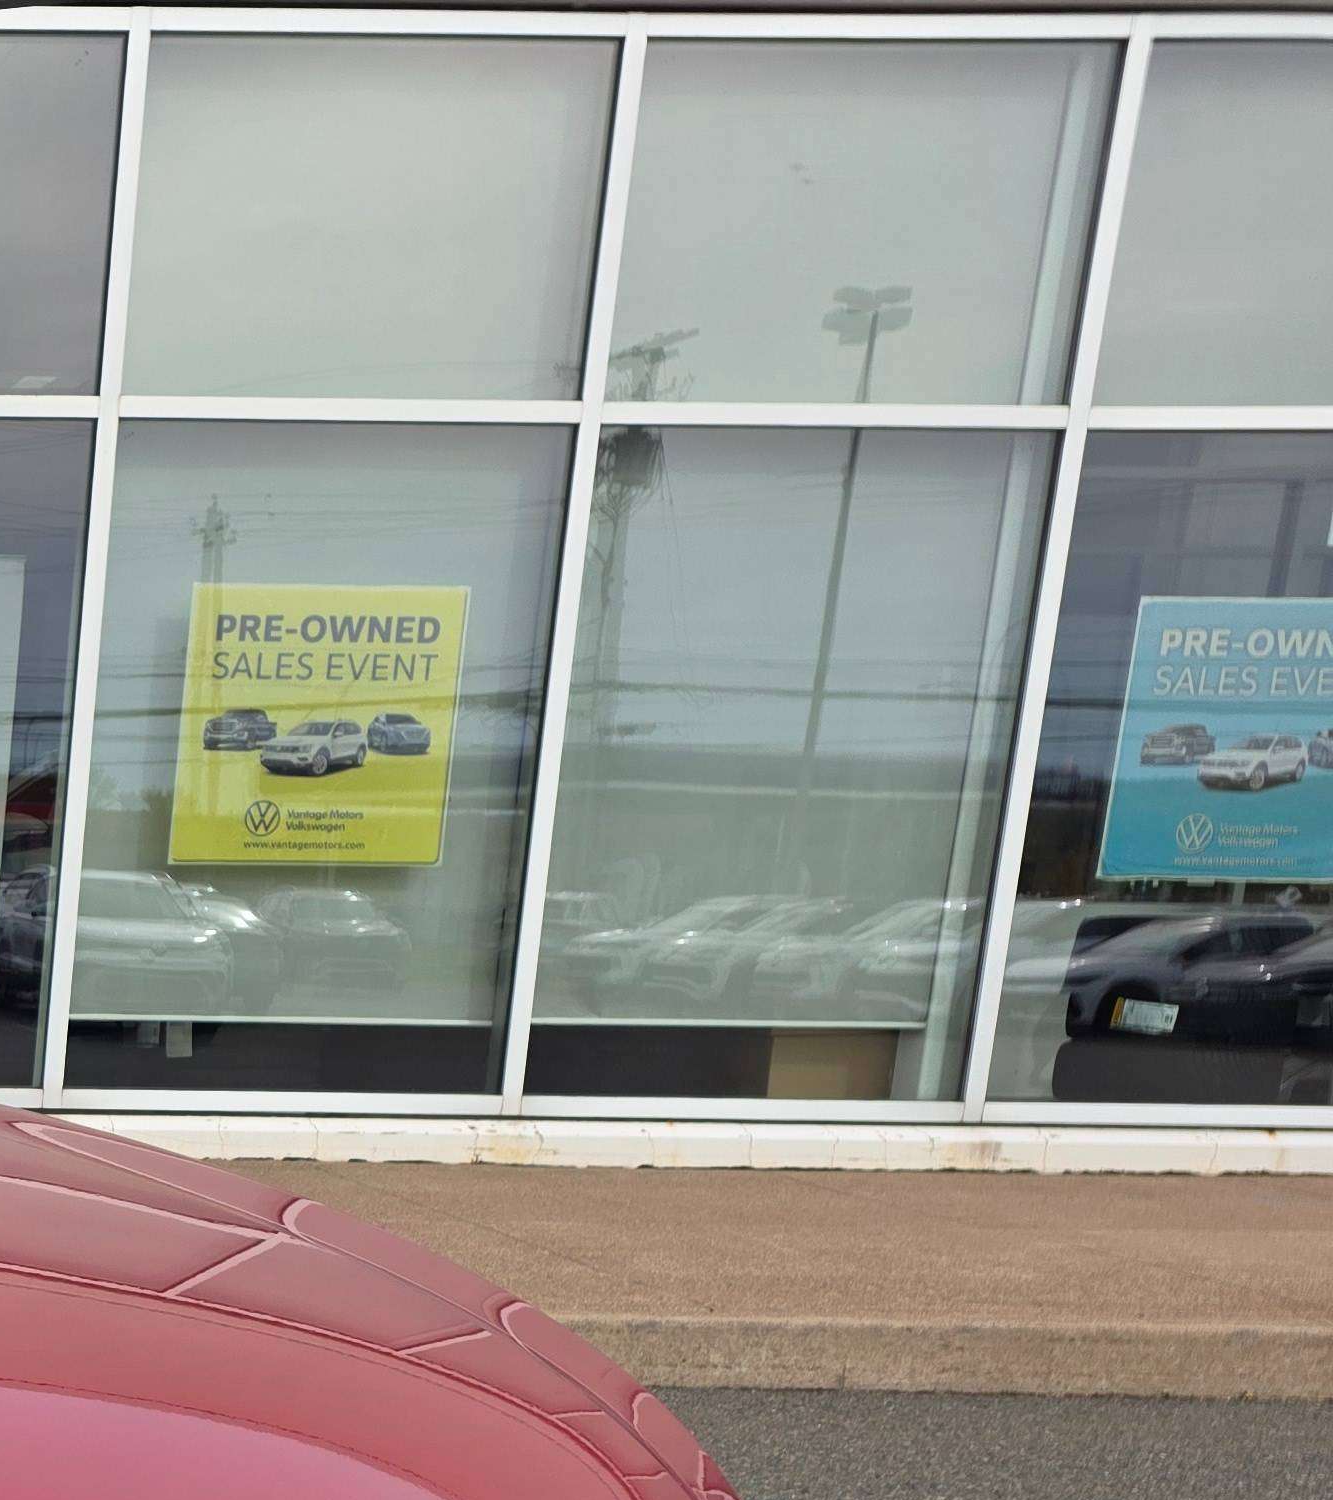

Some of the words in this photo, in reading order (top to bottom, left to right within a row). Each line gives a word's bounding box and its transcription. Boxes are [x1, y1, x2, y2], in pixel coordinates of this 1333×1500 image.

[215, 614, 441, 644] PRE-OWNED
[212, 651, 314, 681] SALES
[325, 653, 440, 682] EVENT
[1153, 664, 1258, 697] SALES
[287, 809, 328, 821] Vantage
[330, 809, 364, 820] Motors
[285, 820, 346, 833] Volkswagen
[243, 840, 366, 851] www.vantagemotors.com
